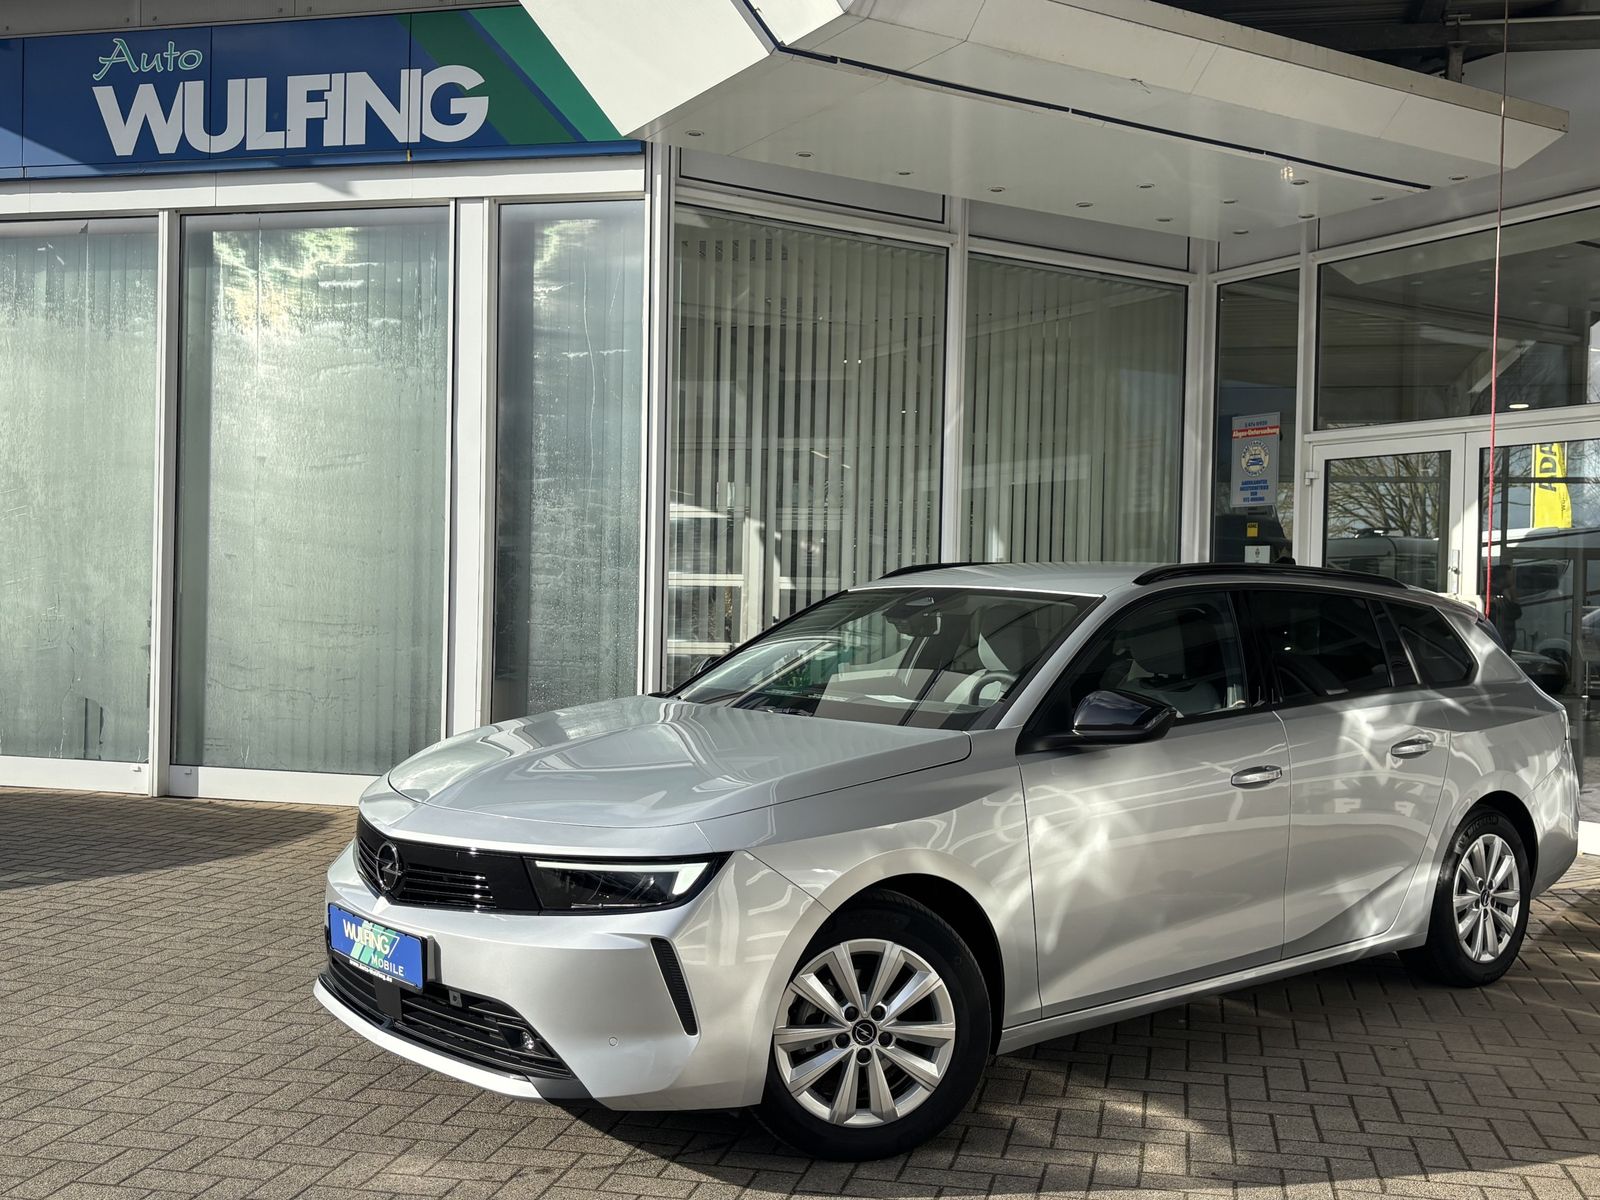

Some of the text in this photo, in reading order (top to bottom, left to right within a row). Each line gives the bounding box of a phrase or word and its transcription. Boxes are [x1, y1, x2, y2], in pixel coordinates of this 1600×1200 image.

[92, 38, 203, 80] Auto
[92, 64, 489, 156] WULFING
[343, 919, 390, 955] WULFING
[371, 953, 405, 977] MOBILE
